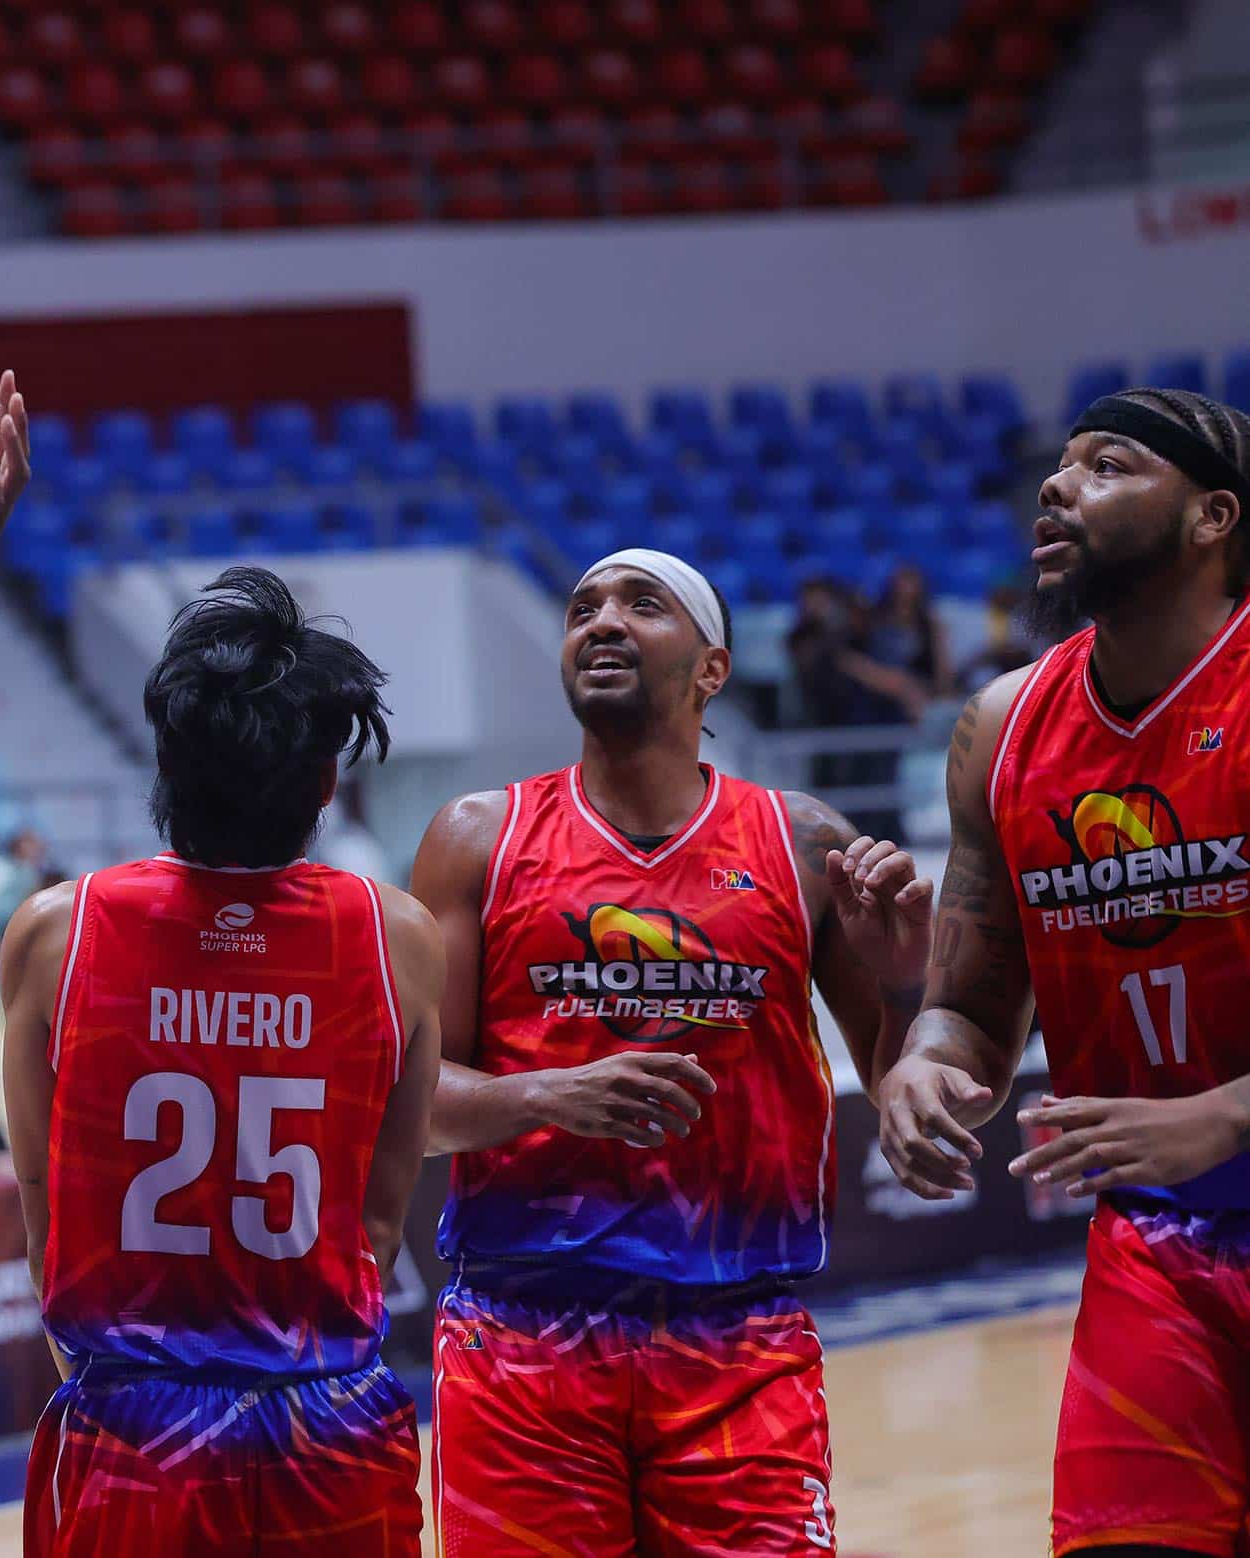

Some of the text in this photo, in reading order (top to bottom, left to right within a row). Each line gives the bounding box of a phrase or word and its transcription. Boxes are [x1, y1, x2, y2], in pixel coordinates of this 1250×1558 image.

[710, 868, 758, 891] PBA
[1021, 836, 1250, 905] PHOENIX
[200, 930, 266, 942] PHOENIX
[200, 941, 266, 953] SUPER LPG
[529, 961, 767, 998] PHOENIX
[150, 987, 312, 1049] RIVERO
[1117, 964, 1187, 1066] 17
[121, 1072, 326, 1260] 25
[803, 1476, 831, 1548] 3
